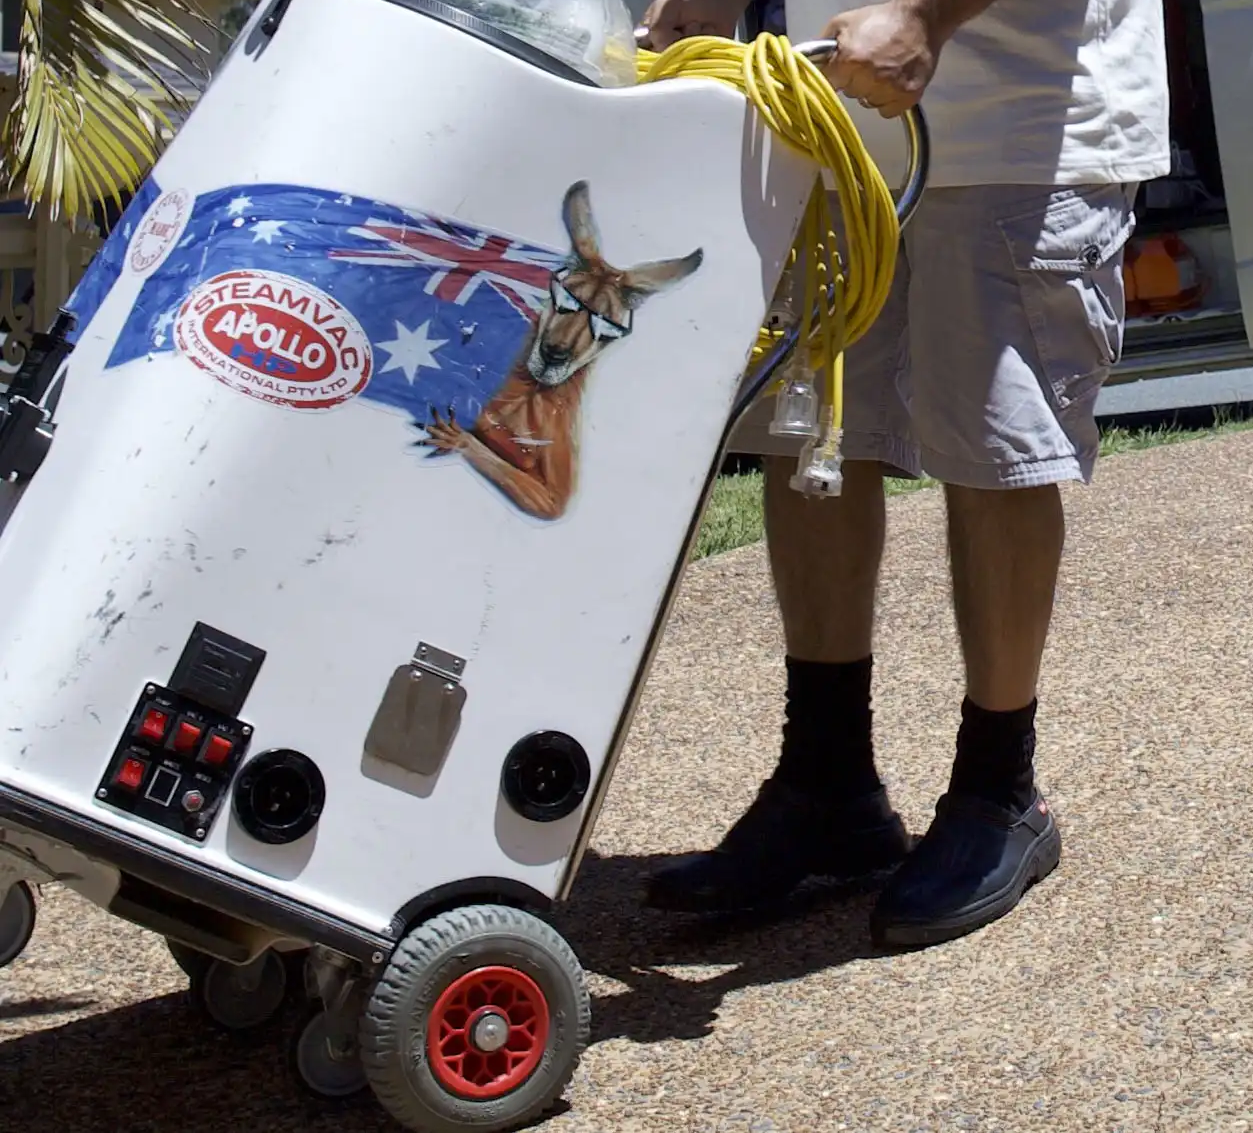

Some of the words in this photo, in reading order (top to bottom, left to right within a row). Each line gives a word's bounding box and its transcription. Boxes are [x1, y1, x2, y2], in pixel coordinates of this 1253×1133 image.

[188, 319, 284, 394] INTERNATIONAL
[286, 385, 318, 397] PTY
[320, 377, 348, 396] LTD
[193, 282, 359, 371] STEAMVAC
[212, 310, 326, 370] APOLLO
